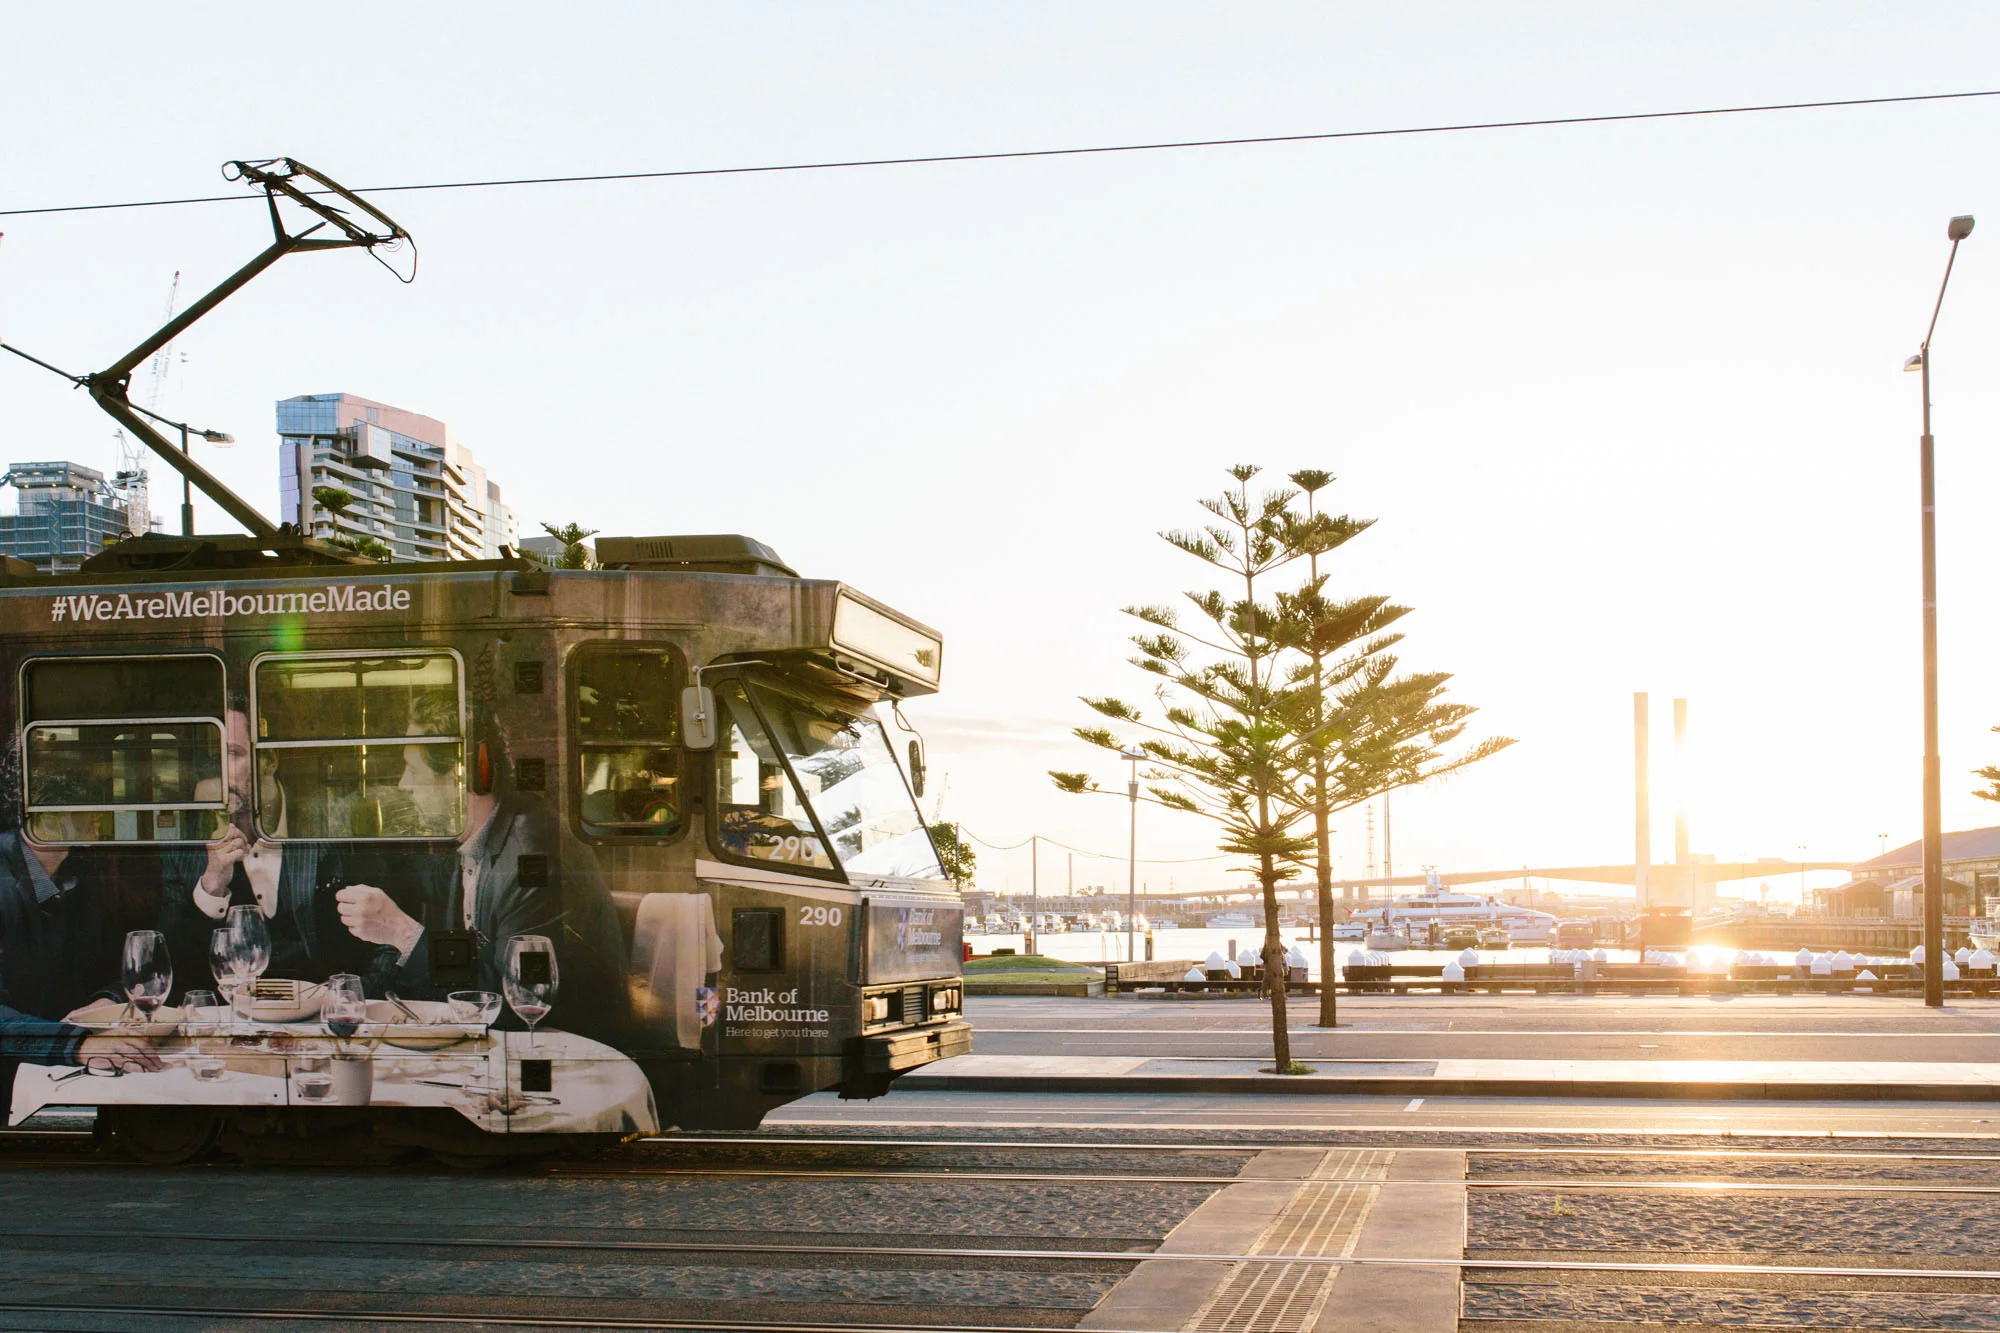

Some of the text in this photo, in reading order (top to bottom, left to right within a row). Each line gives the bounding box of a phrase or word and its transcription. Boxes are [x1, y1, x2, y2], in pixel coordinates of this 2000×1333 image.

[51, 585, 411, 622] #WeAreMelbourneMade
[768, 835, 815, 861] 290
[800, 906, 842, 927] 290
[726, 987, 799, 1005] Bank of
[726, 1005, 829, 1022] Melbourne
[726, 1026, 829, 1039] Here to get you there
